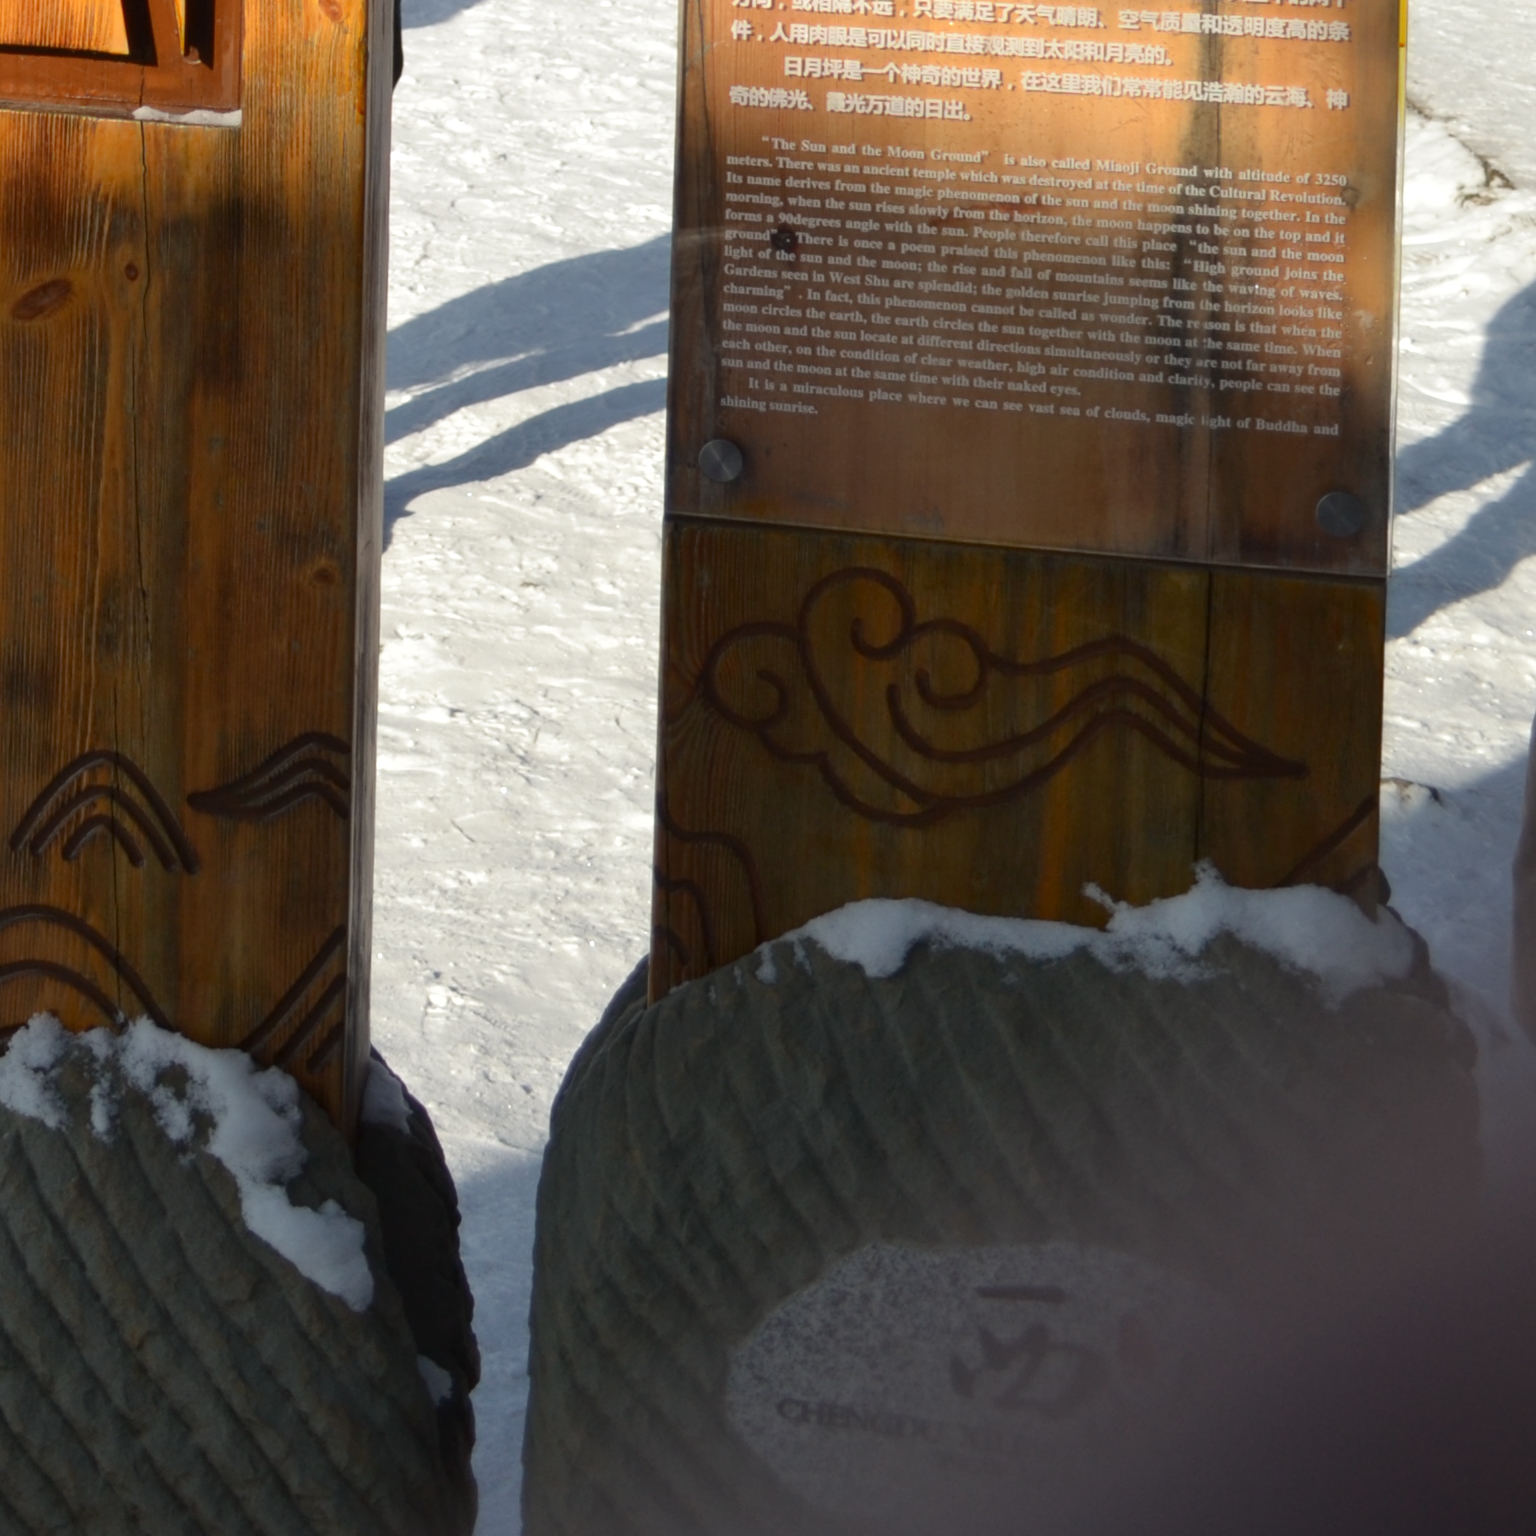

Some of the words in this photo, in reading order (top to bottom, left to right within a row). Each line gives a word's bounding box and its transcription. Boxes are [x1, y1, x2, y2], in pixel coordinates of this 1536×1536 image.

[774, 156, 814, 171] There
[816, 162, 841, 173] was
[843, 163, 860, 174] an
[862, 162, 909, 177] ancient
[912, 166, 956, 183] temple
[959, 169, 998, 183] which
[1001, 174, 1026, 185] was
[1028, 173, 1092, 192] destroyed
[1095, 178, 1108, 191] at
[1111, 179, 1132, 192] the
[1135, 180, 1165, 194] time
[1167, 182, 1182, 195] of
[1184, 183, 1206, 197] the
[1208, 185, 1266, 201] Cultural
[800, 139, 826, 153] Sun
[831, 141, 855, 155] and
[861, 143, 882, 156] the
[886, 145, 924, 159] Moon
[1002, 152, 1014, 165] is
[1019, 153, 1046, 167] also
[1050, 155, 1090, 170] called
[1095, 158, 1139, 175] Miaoji
[1144, 161, 1197, 177] Ground
[1202, 165, 1232, 179] with
[1238, 167, 1290, 183] altitude
[1294, 171, 1310, 184] of
[1314, 172, 1347, 187] 3250
[725, 172, 743, 185] Its
[746, 176, 781, 187] name
[784, 176, 830, 191] derives
[834, 179, 866, 193] from
[869, 181, 890, 195] the
[894, 183, 932, 200] magic
[937, 186, 1020, 206] phenomenon
[1023, 192, 1038, 205] of
[1041, 193, 1062, 206] the
[1065, 197, 1089, 208] sun
[1092, 196, 1118, 210] and
[1121, 198, 1143, 212] the
[1146, 202, 1184, 215] moon
[1187, 203, 1237, 220] shining
[1305, 210, 1320, 224] In
[1323, 212, 1346, 225] the
[787, 195, 821, 209] when
[824, 197, 845, 210] the
[848, 201, 871, 212] sun
[875, 200, 905, 214] rises
[908, 203, 948, 220] slowly
[952, 206, 985, 220] from
[988, 208, 1009, 222] the
[1071, 214, 1092, 227] the
[1096, 218, 1133, 230] moon
[1136, 218, 1192, 236] happens
[1195, 222, 1210, 235] to
[1213, 223, 1229, 237] be
[1232, 227, 1250, 238] on
[1253, 226, 1275, 240] the
[1278, 228, 1301, 244] top
[1304, 230, 1330, 244] and
[1334, 232, 1345, 244] it
[724, 208, 762, 223] forms
[766, 214, 774, 224] a
[777, 212, 841, 230] 90degrees
[845, 217, 880, 233] angle
[884, 219, 912, 233] with
[916, 222, 937, 235] the
[972, 225, 1016, 243] People
[1020, 229, 1081, 245] therefore
[1084, 233, 1108, 247] call
[1112, 235, 1137, 249] this
[1142, 237, 1177, 254] place
[1222, 245, 1247, 256] sun
[1251, 244, 1276, 258] and
[1280, 246, 1302, 260] the
[1306, 251, 1344, 263] moon
[722, 263, 778, 279] Gardens
[780, 270, 808, 281] seen
[812, 270, 825, 283] in
[828, 271, 860, 285] West
[864, 273, 889, 287] Shu
[893, 278, 914, 289] are
[981, 282, 1002, 295] the
[1005, 283, 1049, 301] golden
[1052, 287, 1100, 302] sunrise
[1103, 290, 1159, 309] jumping
[1162, 295, 1195, 309] from
[1223, 299, 1275, 315] horizon
[720, 357, 743, 368] sun
[746, 356, 770, 370] and
[773, 358, 794, 372] the
[796, 362, 832, 375] moon
[834, 363, 847, 376] at
[850, 364, 871, 378] the
[873, 368, 906, 380] same
[909, 368, 938, 383] time
[941, 371, 969, 385] with
[972, 373, 1004, 388] their
[1007, 376, 1046, 391] naked
[719, 395, 766, 412] shining
[748, 378, 759, 391] It
[763, 379, 775, 392] is
[779, 383, 787, 393] a
[792, 381, 864, 399] miraculous
[868, 387, 902, 404] place
[907, 390, 947, 405] where
[951, 396, 970, 407] we
[973, 398, 998, 409] can
[1002, 400, 1023, 411] see
[1028, 399, 1054, 413] vast
[1059, 404, 1080, 415] sea
[1084, 404, 1100, 417] of
[1154, 409, 1195, 426] magic
[1235, 415, 1251, 429] of
[1255, 417, 1308, 433] Buddha
[1312, 421, 1339, 435] and
